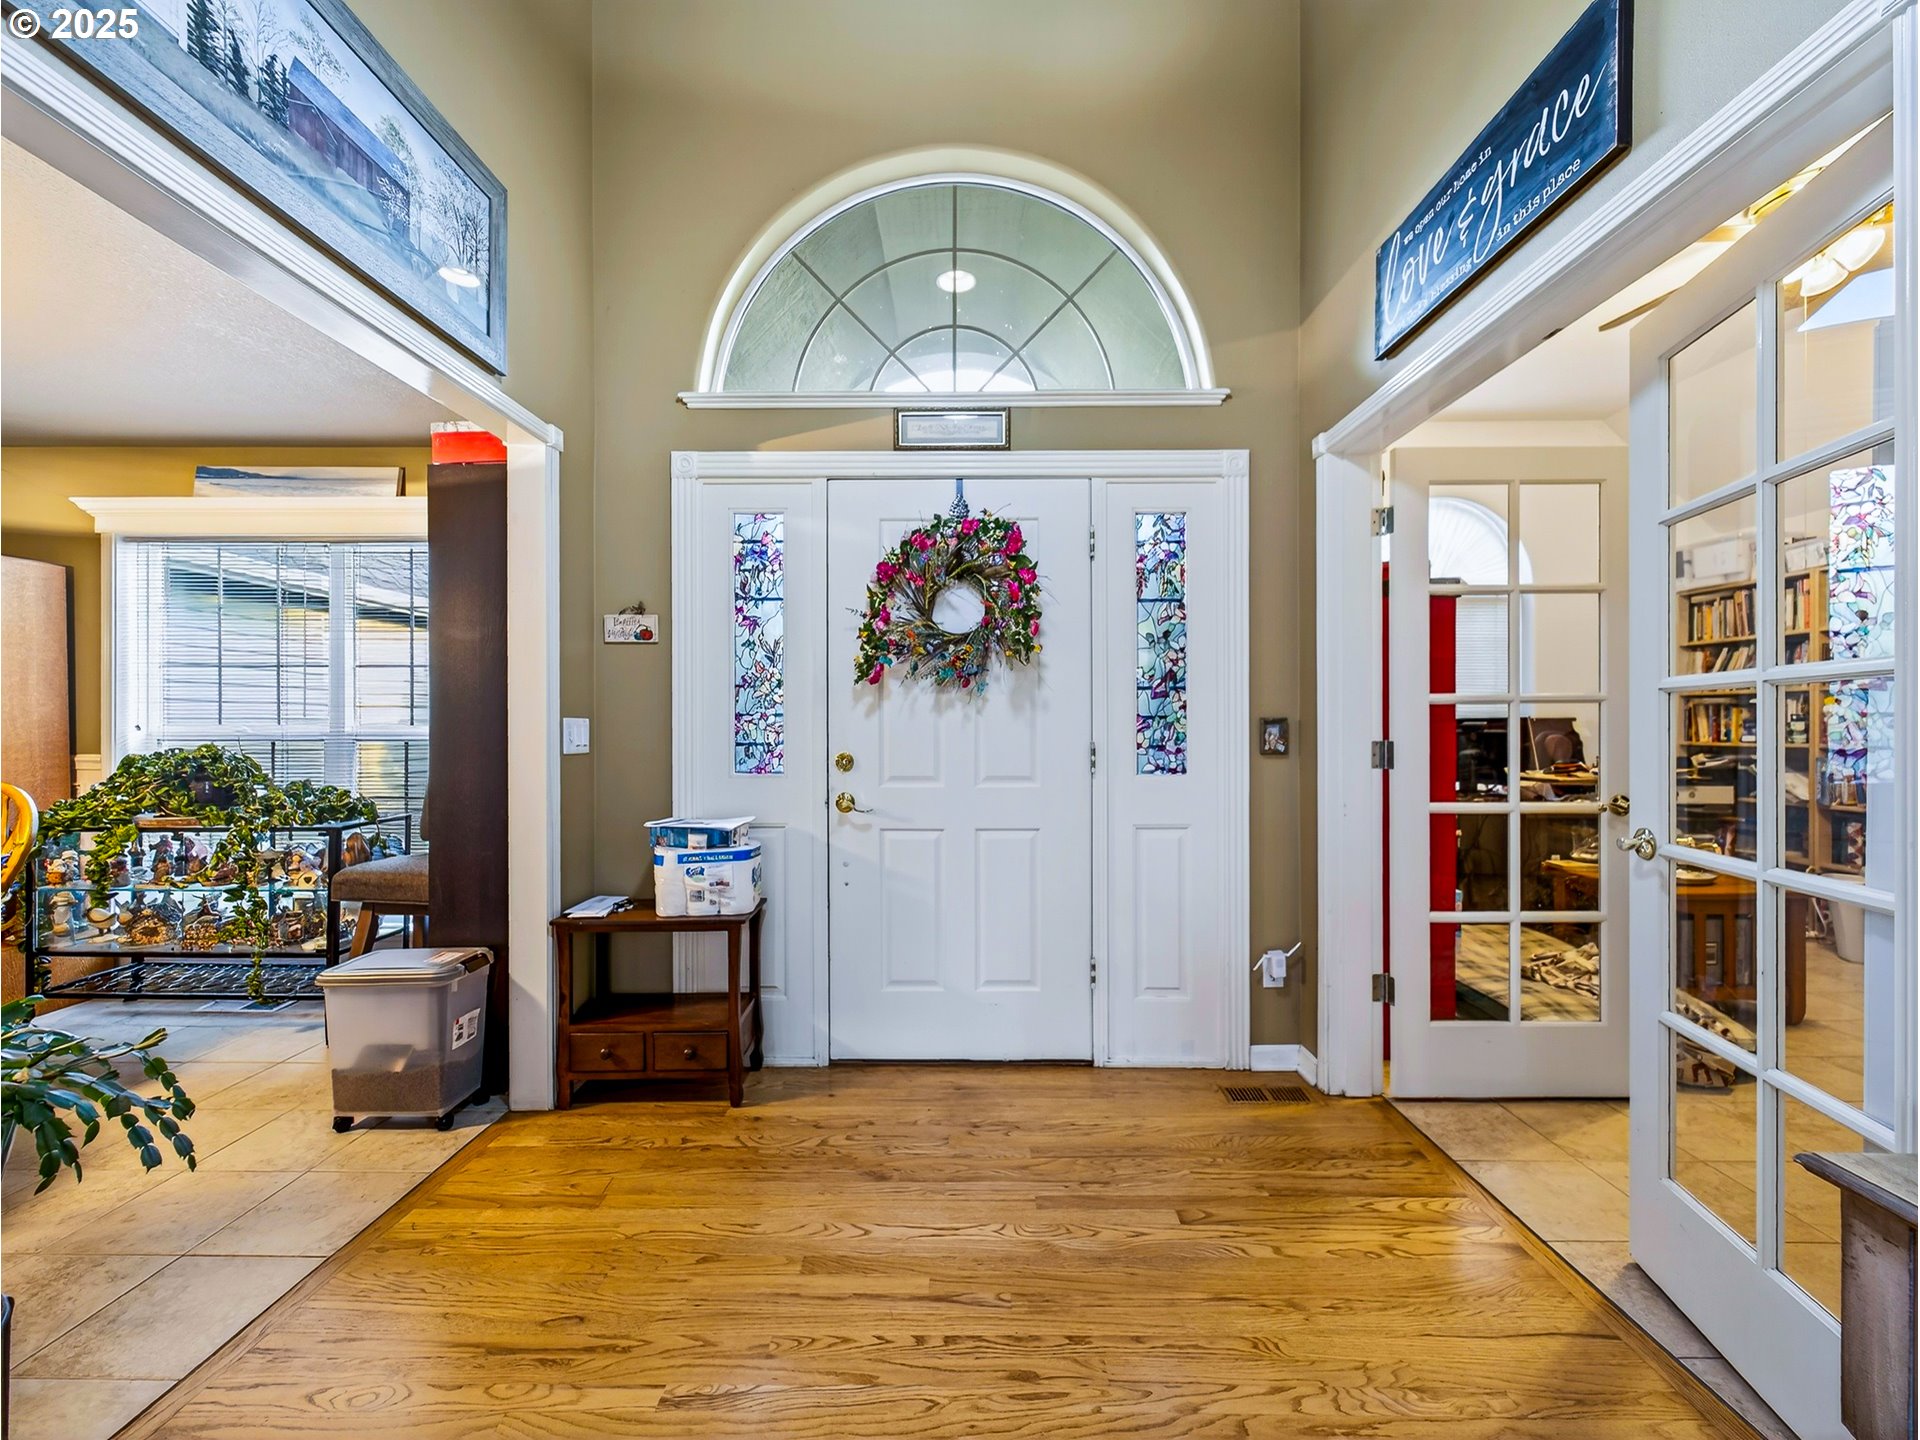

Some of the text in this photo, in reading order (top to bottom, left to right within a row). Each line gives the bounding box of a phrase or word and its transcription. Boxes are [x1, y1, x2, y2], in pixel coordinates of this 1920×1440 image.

[1383, 219, 1456, 325] love
[1472, 62, 1608, 264] grace
[1415, 208, 1435, 234] open
[1435, 187, 1452, 212] our
[1453, 161, 1478, 193] home
[1478, 146, 1491, 166] in
[1496, 222, 1511, 242] in
[1513, 195, 1540, 226] this
[1543, 158, 1581, 205] place
